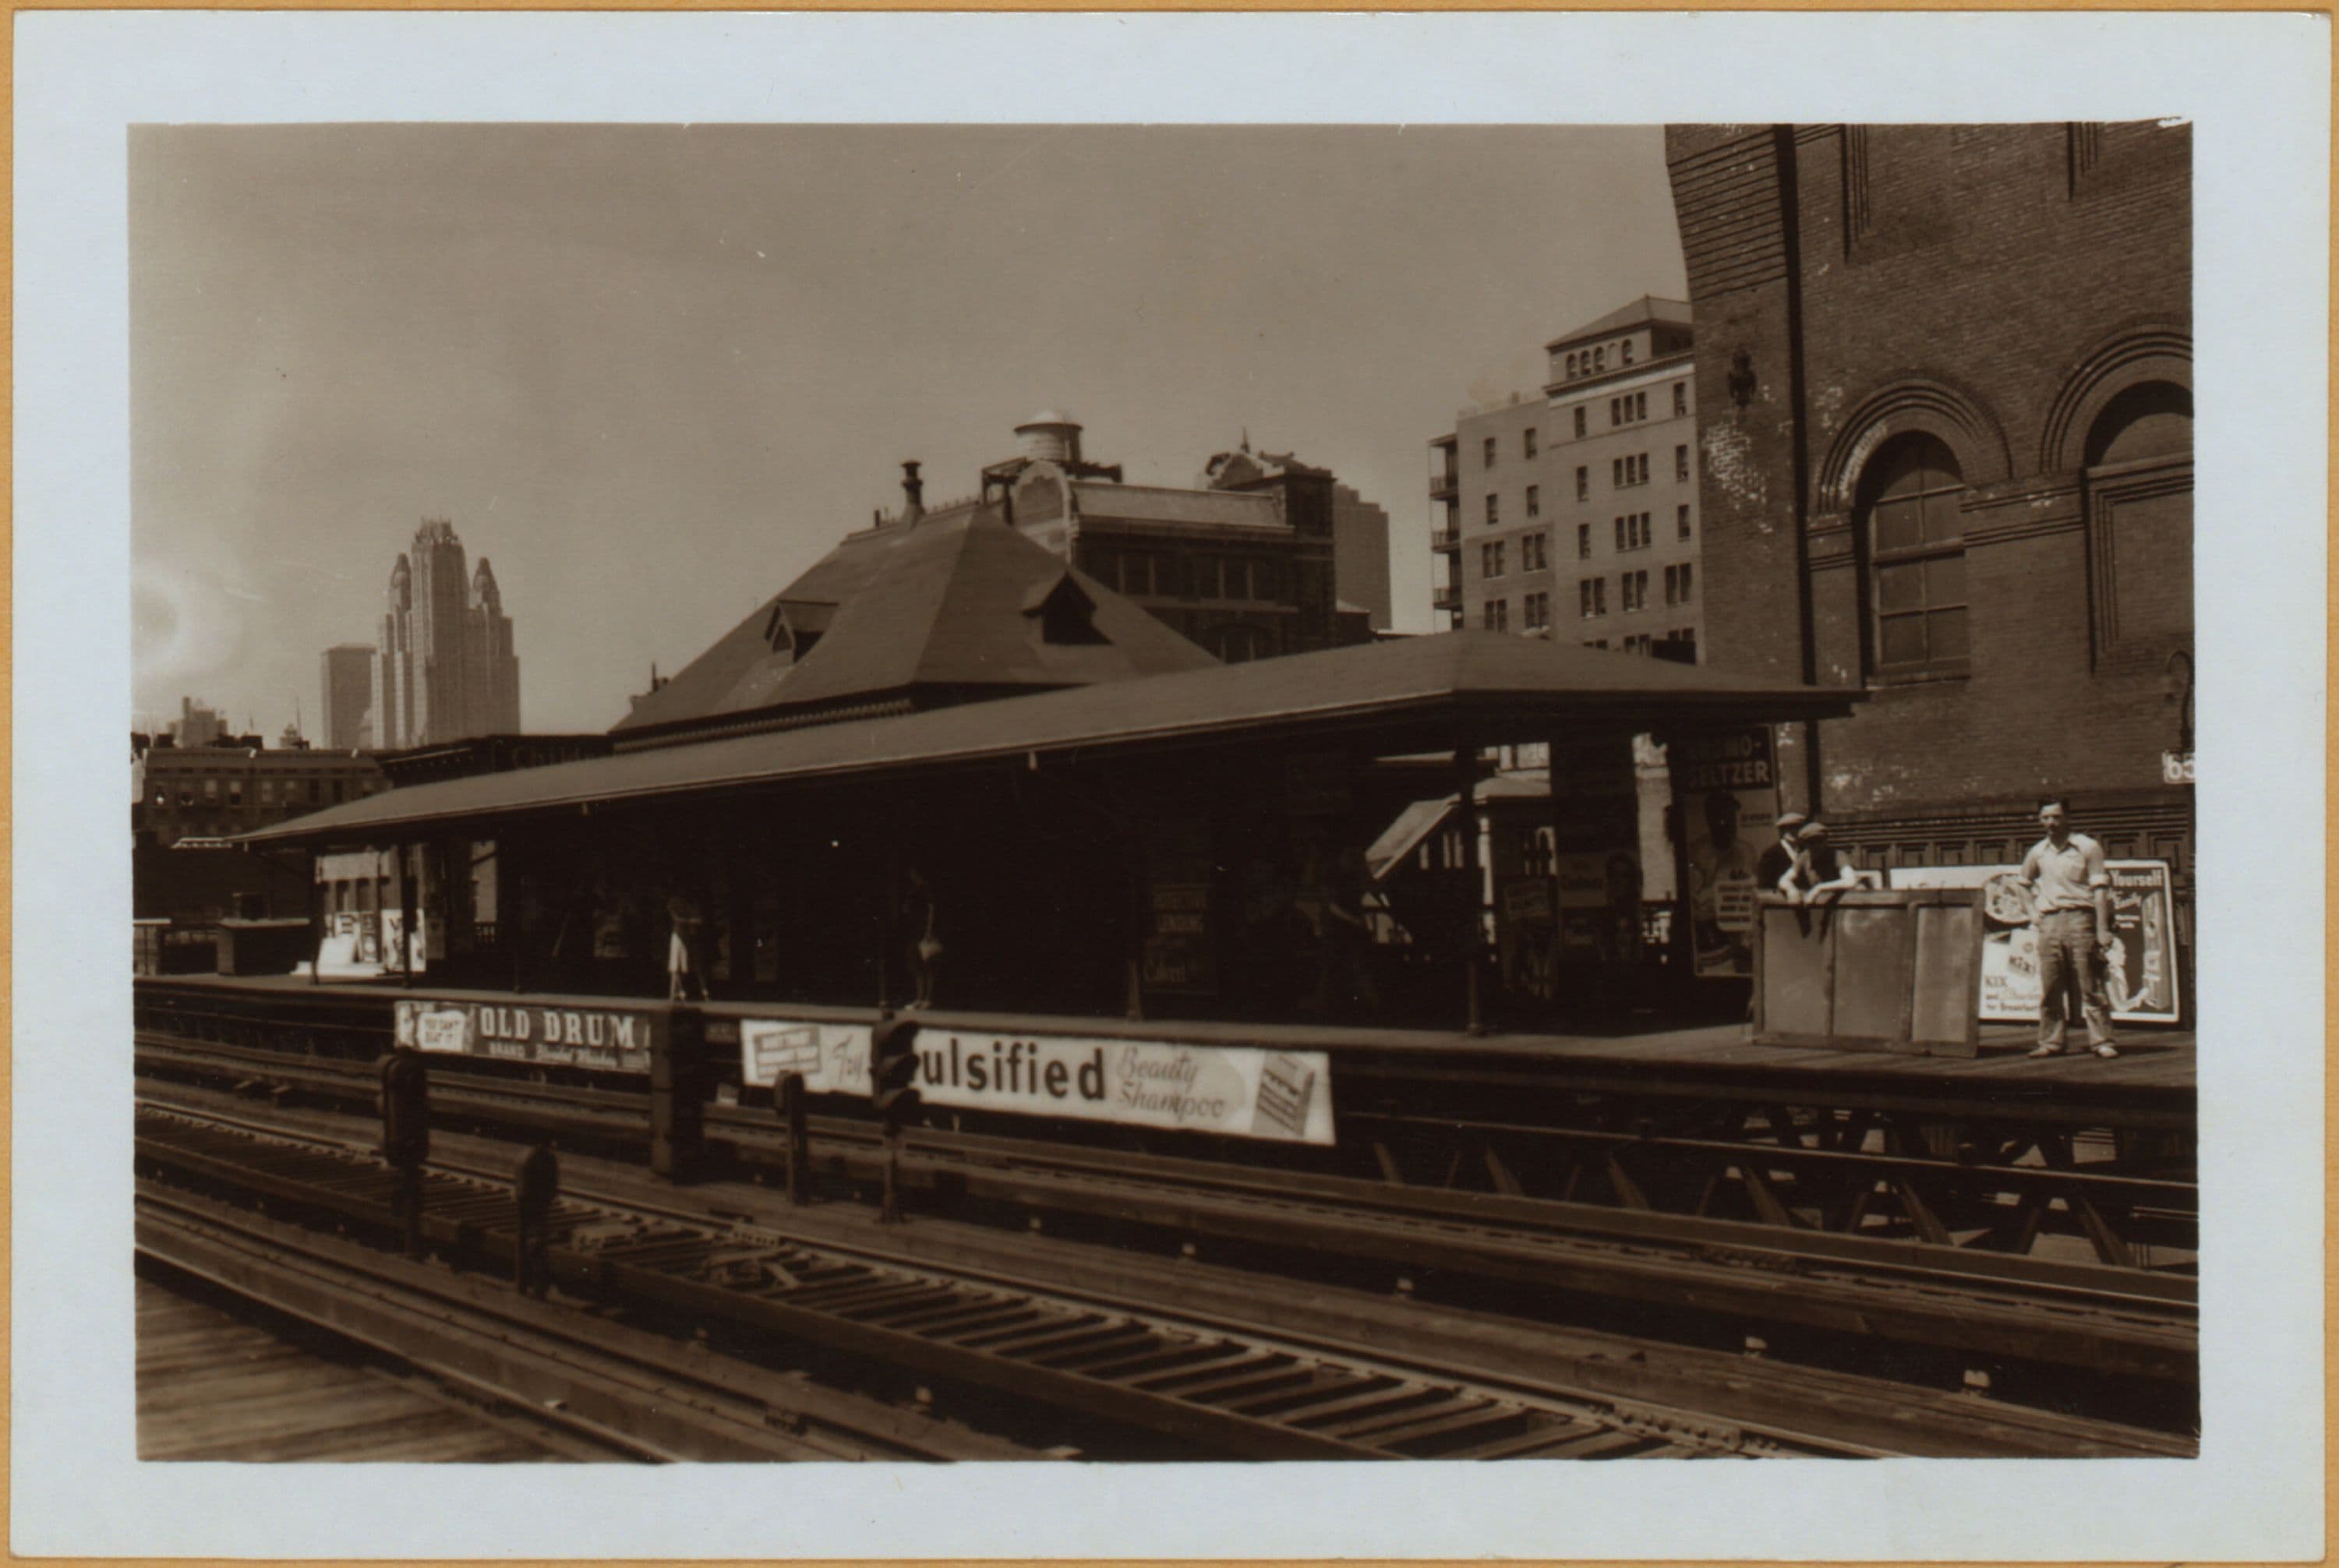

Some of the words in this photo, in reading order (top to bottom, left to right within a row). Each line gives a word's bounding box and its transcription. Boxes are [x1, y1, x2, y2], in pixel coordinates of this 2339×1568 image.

[2109, 868, 2164, 887] Yourself
[480, 1006, 531, 1040] OLD
[543, 1010, 637, 1050] DRUM
[923, 1037, 1106, 1101] ulsified
[1116, 1046, 1199, 1094] Beauty
[1117, 1080, 1226, 1122] Shampoo
